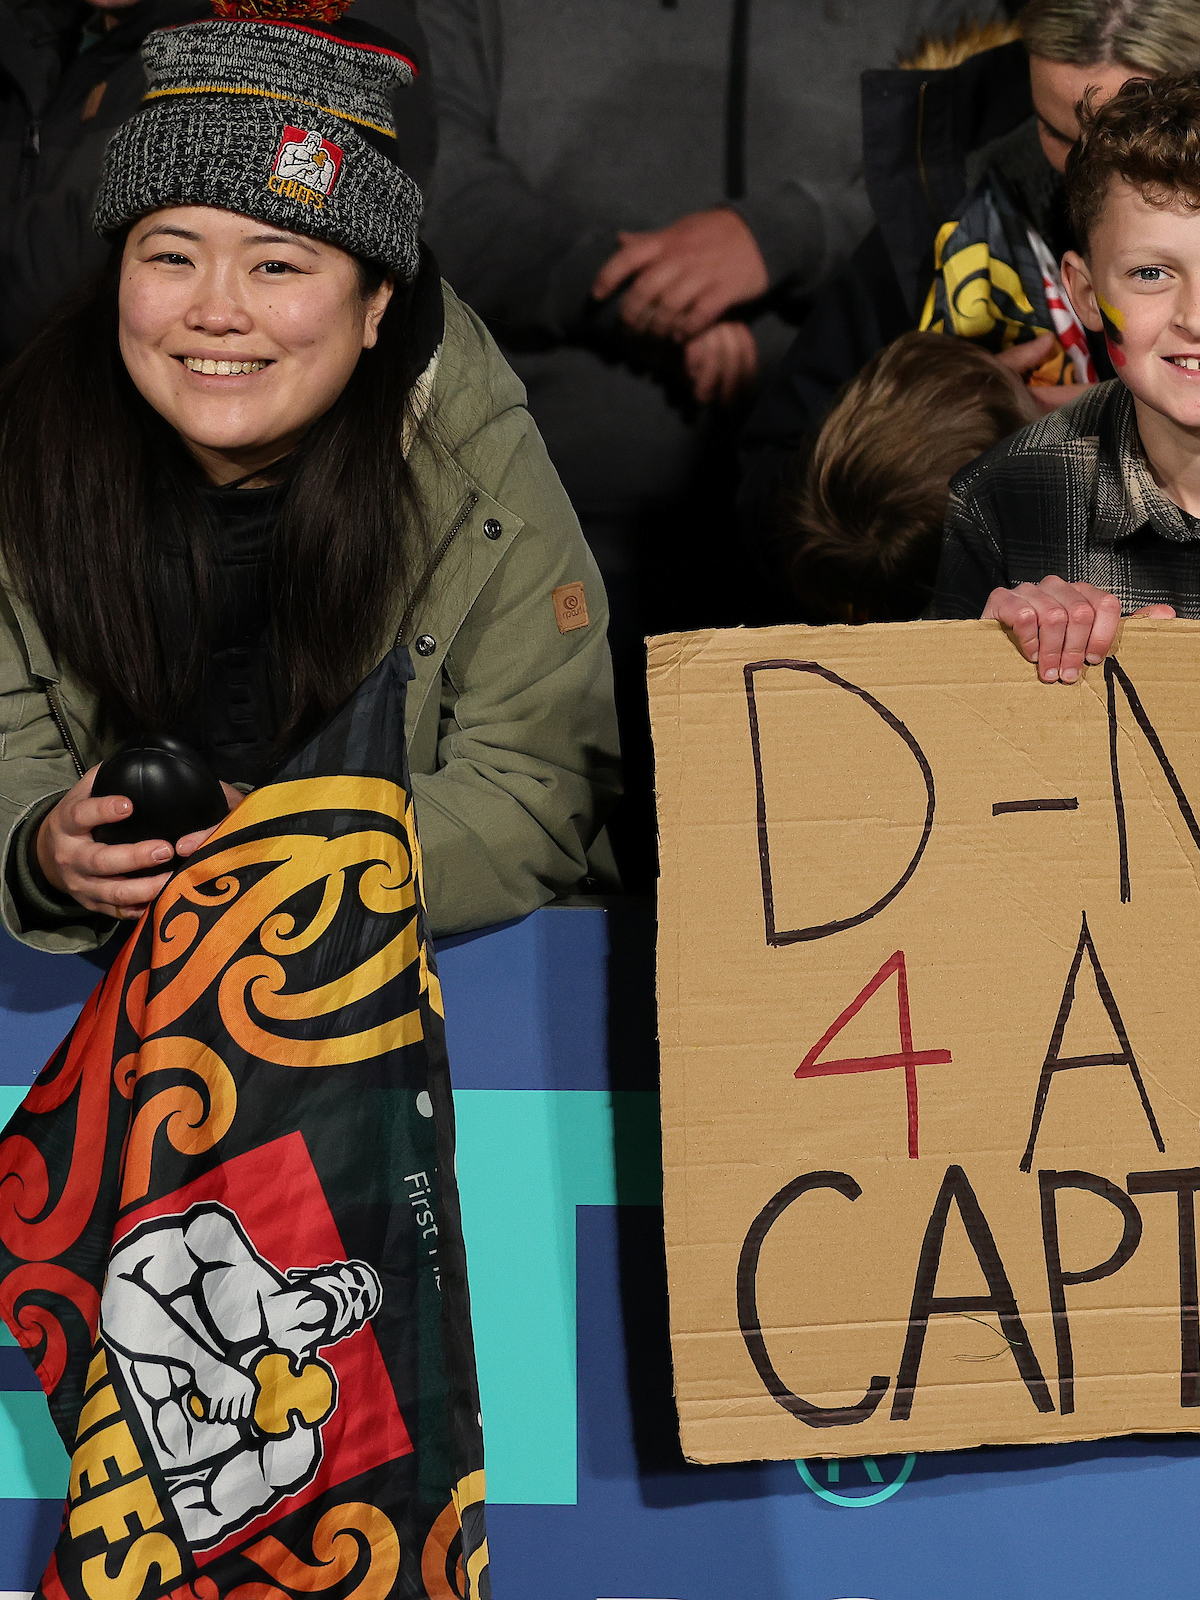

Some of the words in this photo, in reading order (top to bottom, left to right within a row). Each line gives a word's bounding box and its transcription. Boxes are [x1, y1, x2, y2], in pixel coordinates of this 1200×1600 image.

[268, 175, 324, 209] CHIEFS
[794, 950, 953, 1160] 4
[404, 1171, 439, 1239] First
